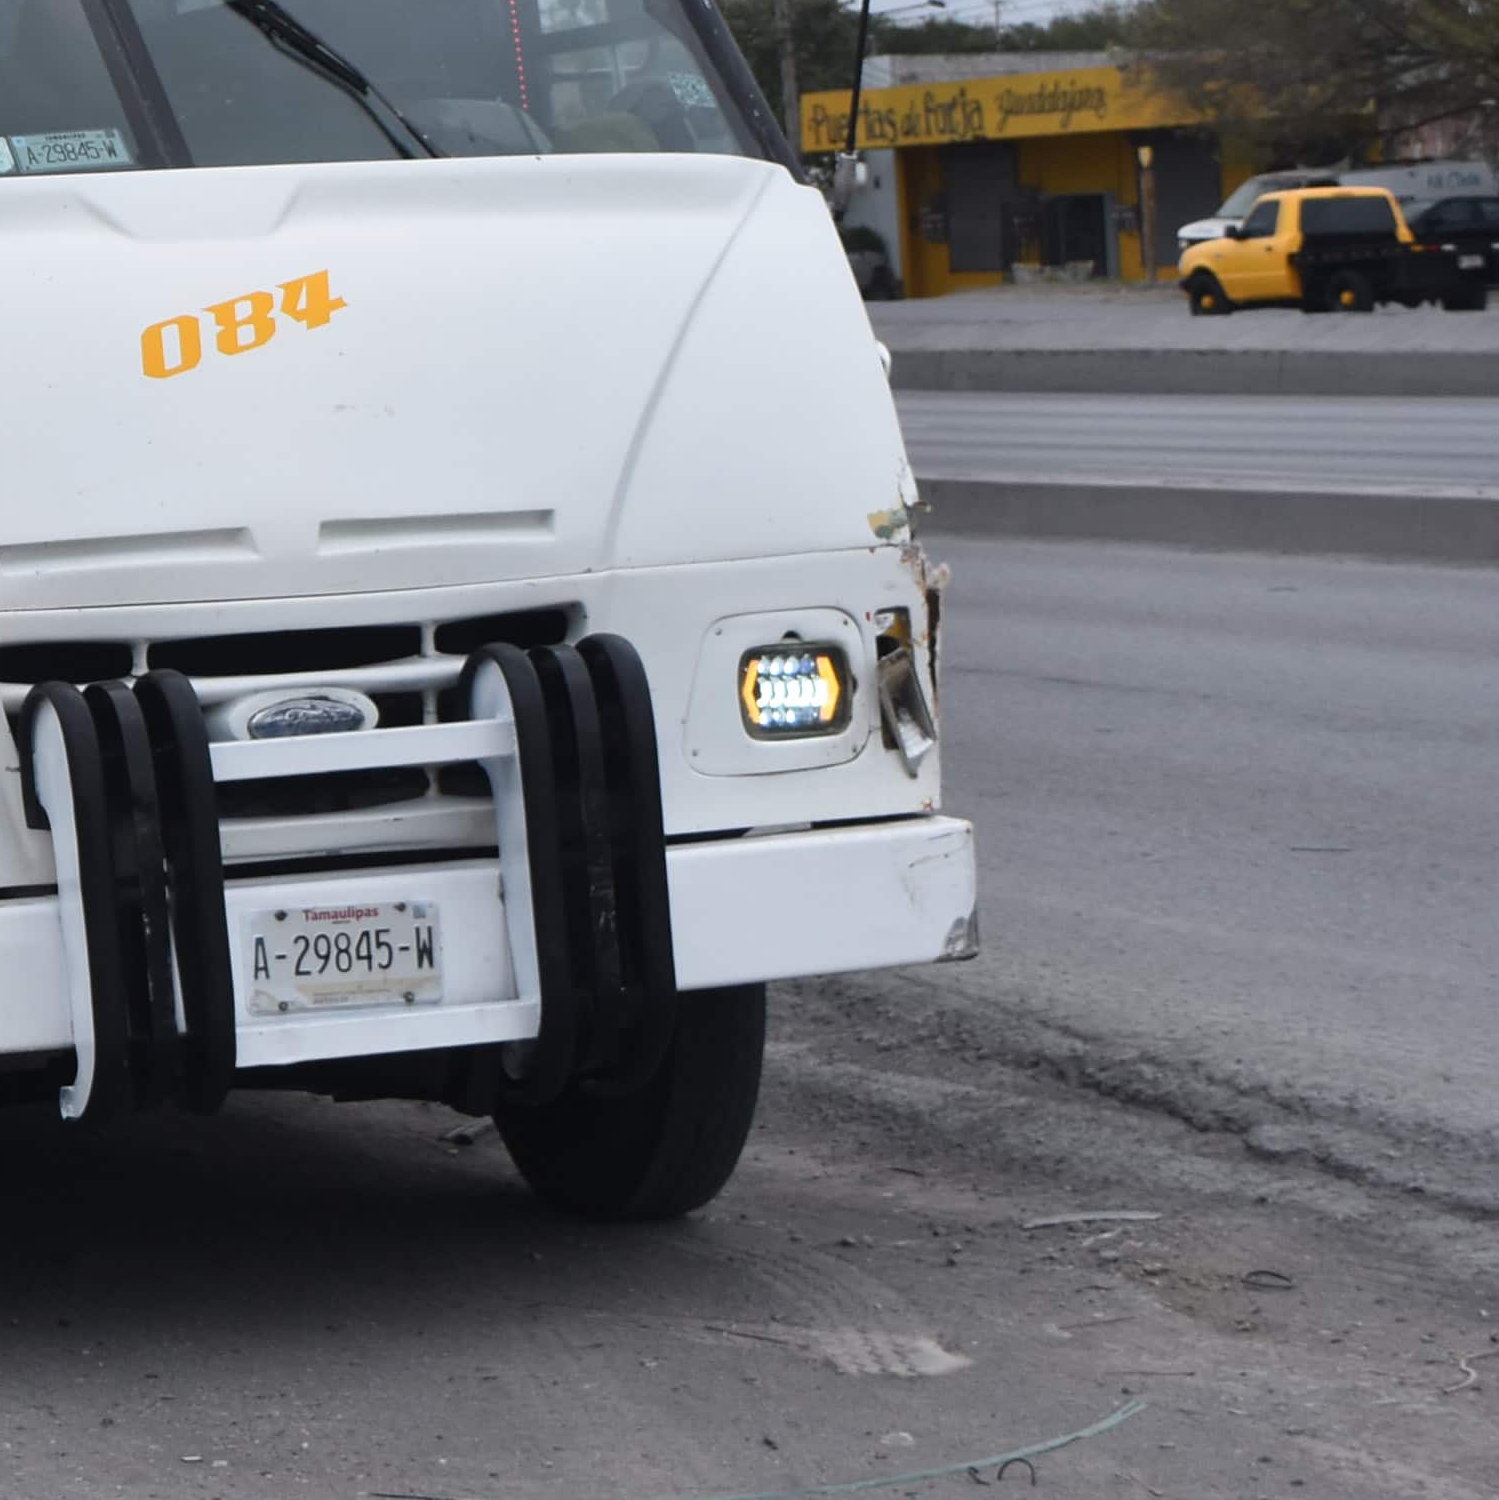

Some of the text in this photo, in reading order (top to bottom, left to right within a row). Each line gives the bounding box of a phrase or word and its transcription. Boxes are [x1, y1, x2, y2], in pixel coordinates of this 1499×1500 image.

[809, 98, 898, 146] Puetas
[26, 140, 118, 165] A-29845-W
[140, 268, 348, 379] 084
[302, 905, 380, 922] Tamaulipas
[253, 925, 435, 981] A-29845-W
